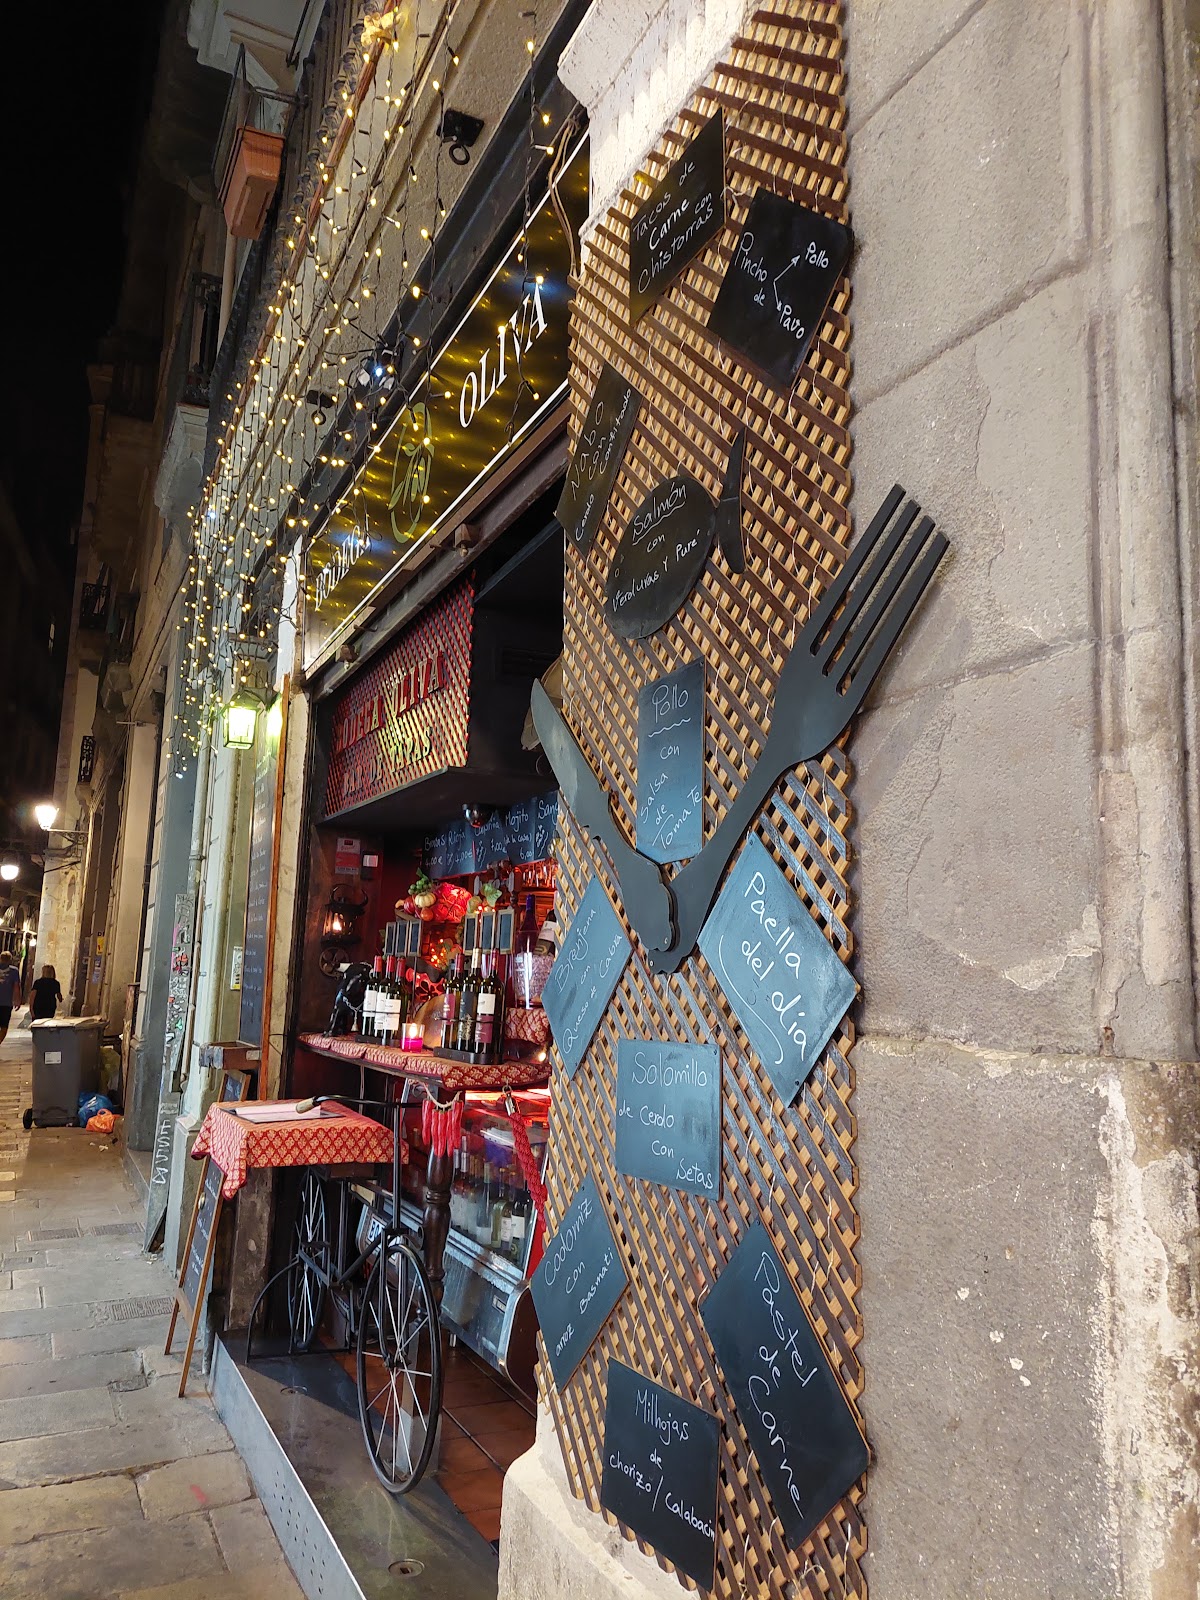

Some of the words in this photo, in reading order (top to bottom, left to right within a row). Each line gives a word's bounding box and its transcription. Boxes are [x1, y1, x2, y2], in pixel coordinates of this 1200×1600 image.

[678, 159, 696, 187] de
[649, 199, 690, 250] Carne
[734, 232, 769, 282] Pincho
[805, 241, 830, 270] Pollo
[753, 288, 766, 307] de
[778, 304, 806, 340] Pavo
[315, 514, 371, 612] BODEGA
[458, 283, 548, 430] OLIVA
[632, 482, 687, 540] Salmón
[391, 651, 444, 717] OLIVA
[652, 684, 690, 723] Pollo
[390, 726, 432, 773] TAPAS
[505, 808, 529, 833] Mojito
[655, 804, 668, 826] de
[744, 871, 802, 979] Paella
[741, 940, 774, 981] del
[562, 1002, 590, 1054] Queso
[631, 1051, 708, 1087] Solomillo
[618, 1100, 633, 1119] de
[639, 1104, 675, 1129] Cerdo
[579, 1247, 614, 1315] Basmati
[753, 1251, 818, 1388] Pastel
[758, 1345, 782, 1389] de
[635, 1389, 690, 1446] Milhojas
[649, 1448, 663, 1470] de
[748, 1374, 805, 1520] Carne
